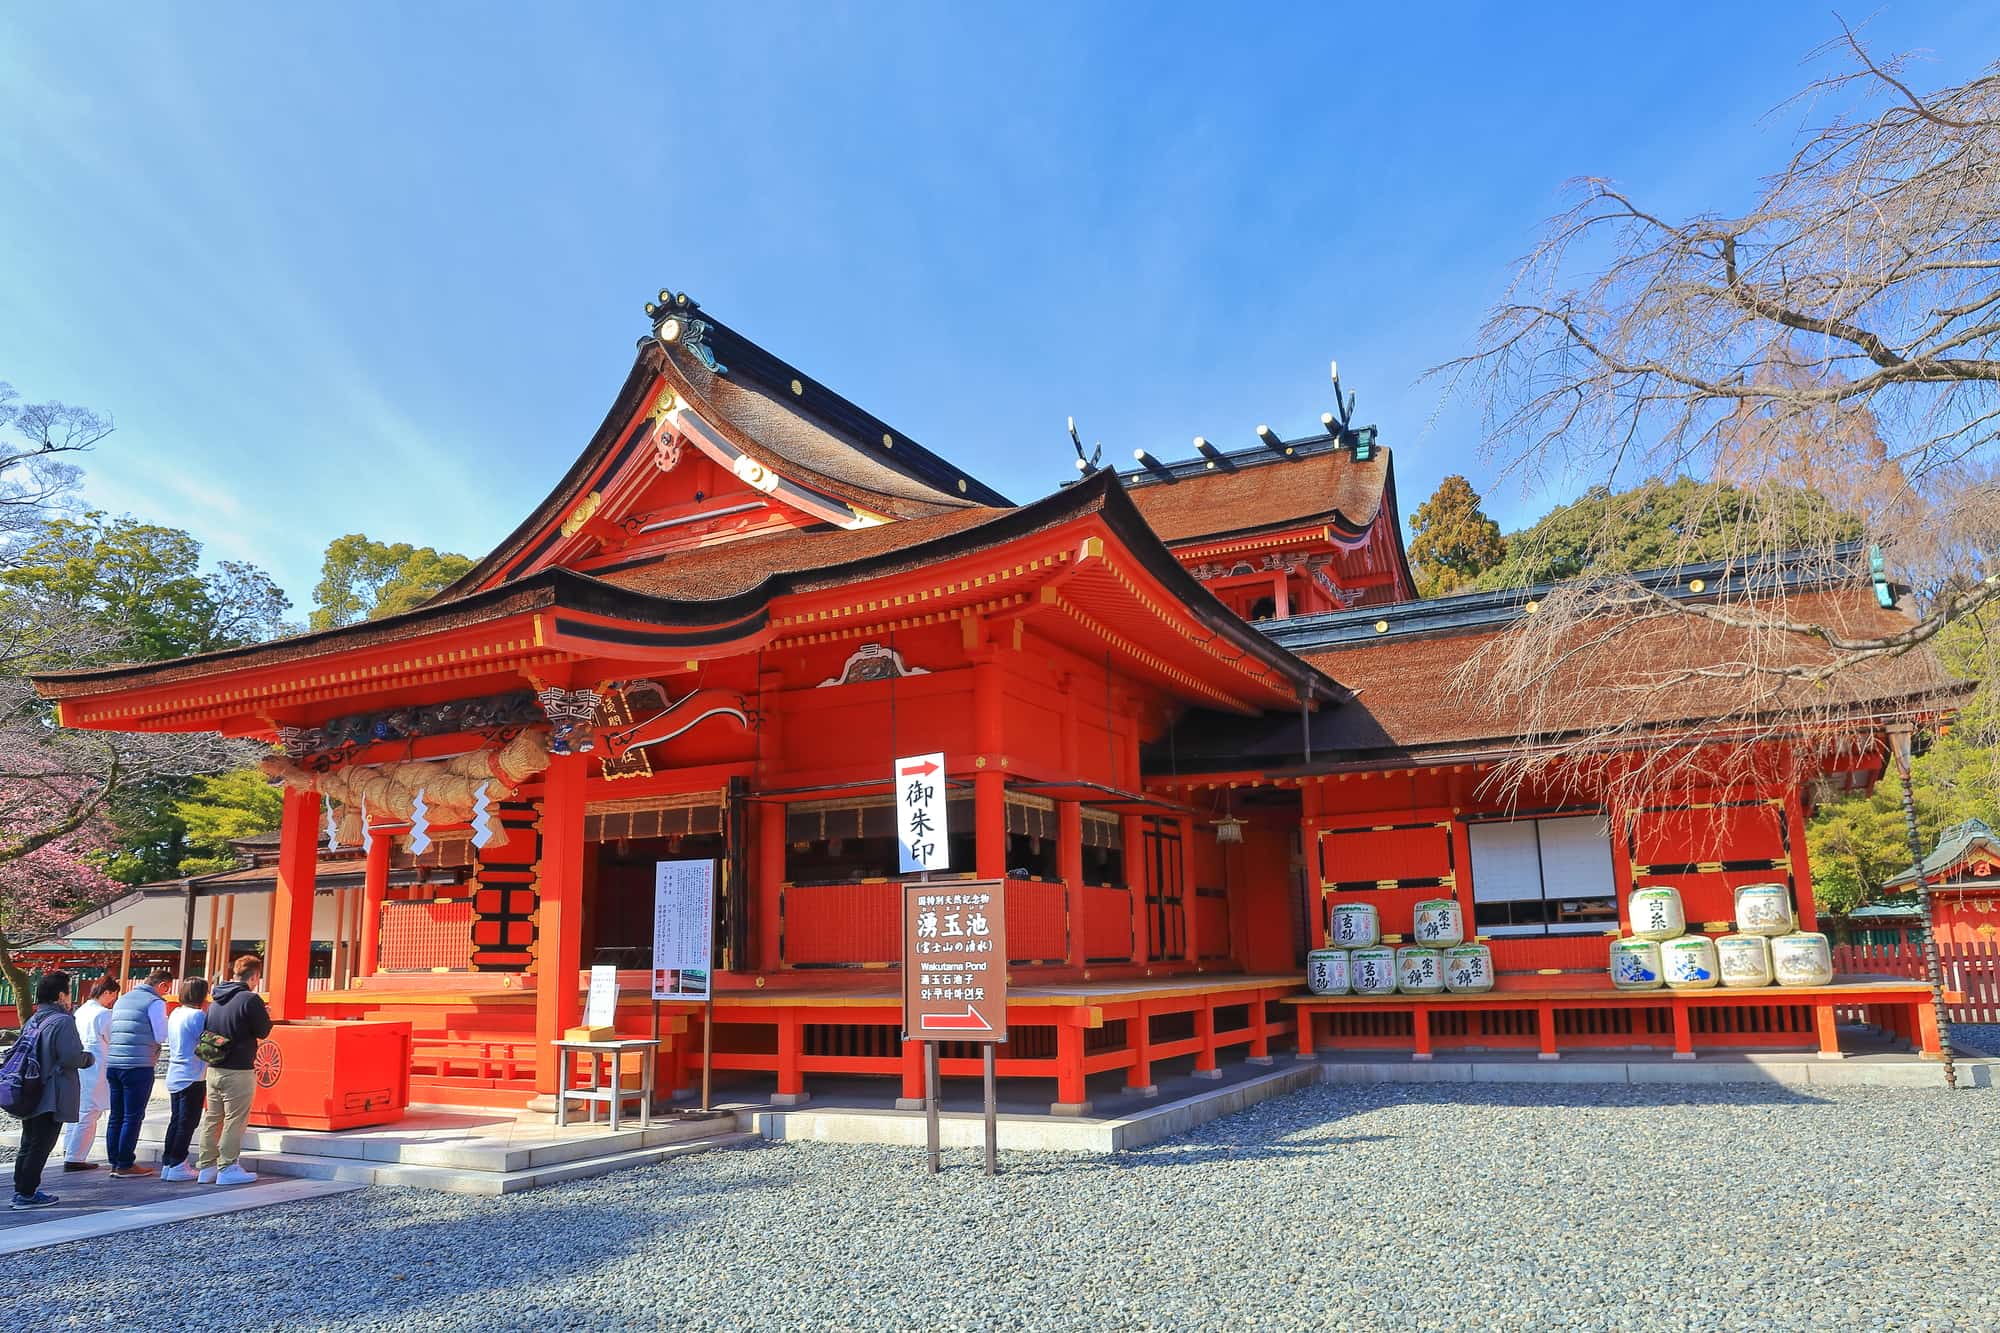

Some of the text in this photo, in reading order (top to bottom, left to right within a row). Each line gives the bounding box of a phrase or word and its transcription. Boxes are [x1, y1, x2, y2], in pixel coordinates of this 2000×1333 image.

[905, 779, 935, 866] 御朱印
[918, 893, 990, 906] 国特別天然記念物
[917, 912, 990, 939] 湧玉池
[920, 961, 988, 971] Wakutama Pond
